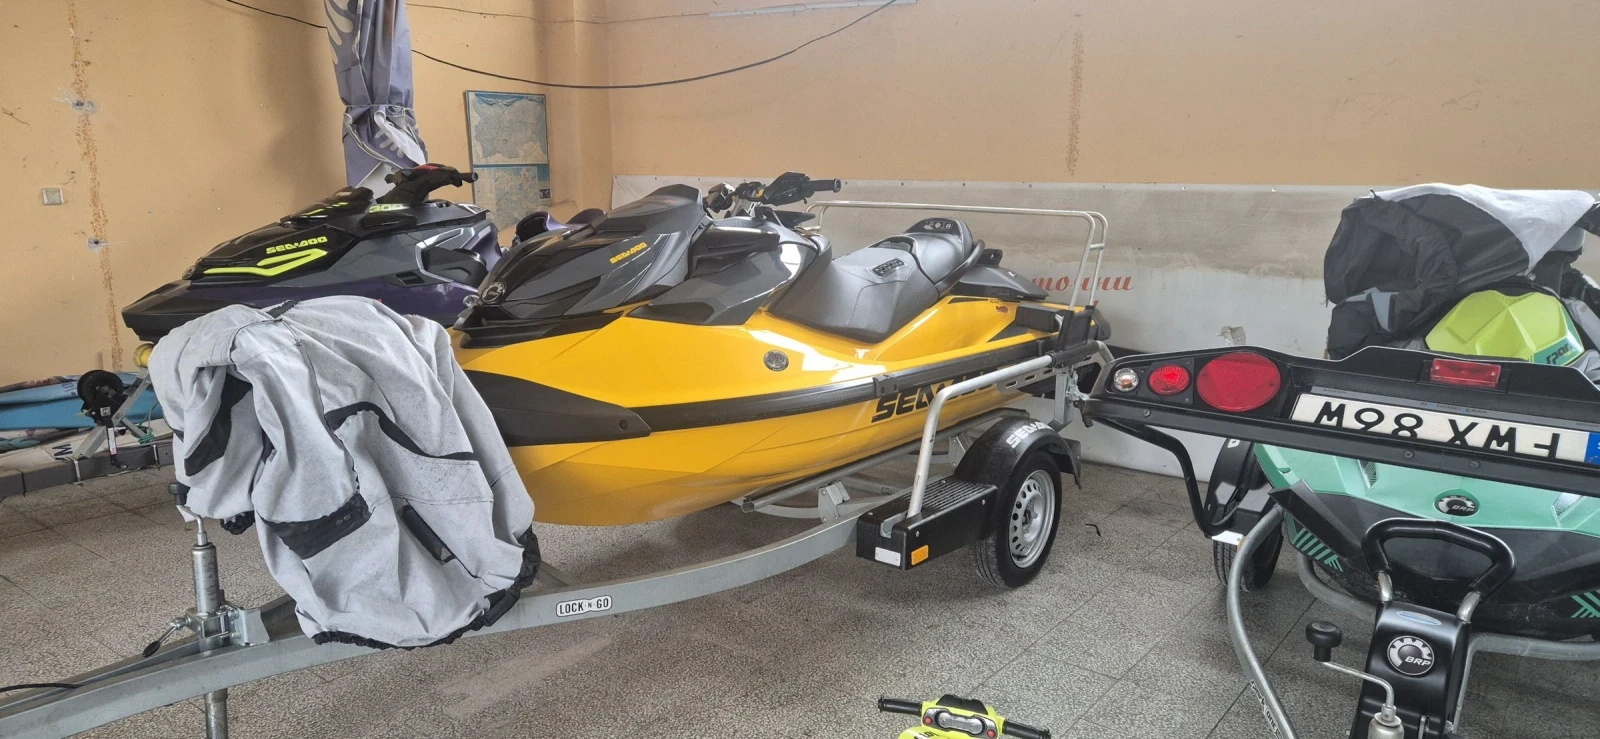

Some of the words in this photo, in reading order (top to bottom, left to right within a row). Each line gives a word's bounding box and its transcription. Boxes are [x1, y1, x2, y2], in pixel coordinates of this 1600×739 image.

[1452, 504, 1475, 512] BRP
[559, 601, 584, 615] LOCK
[596, 597, 609, 609] GO
[1405, 655, 1431, 666] BRP
